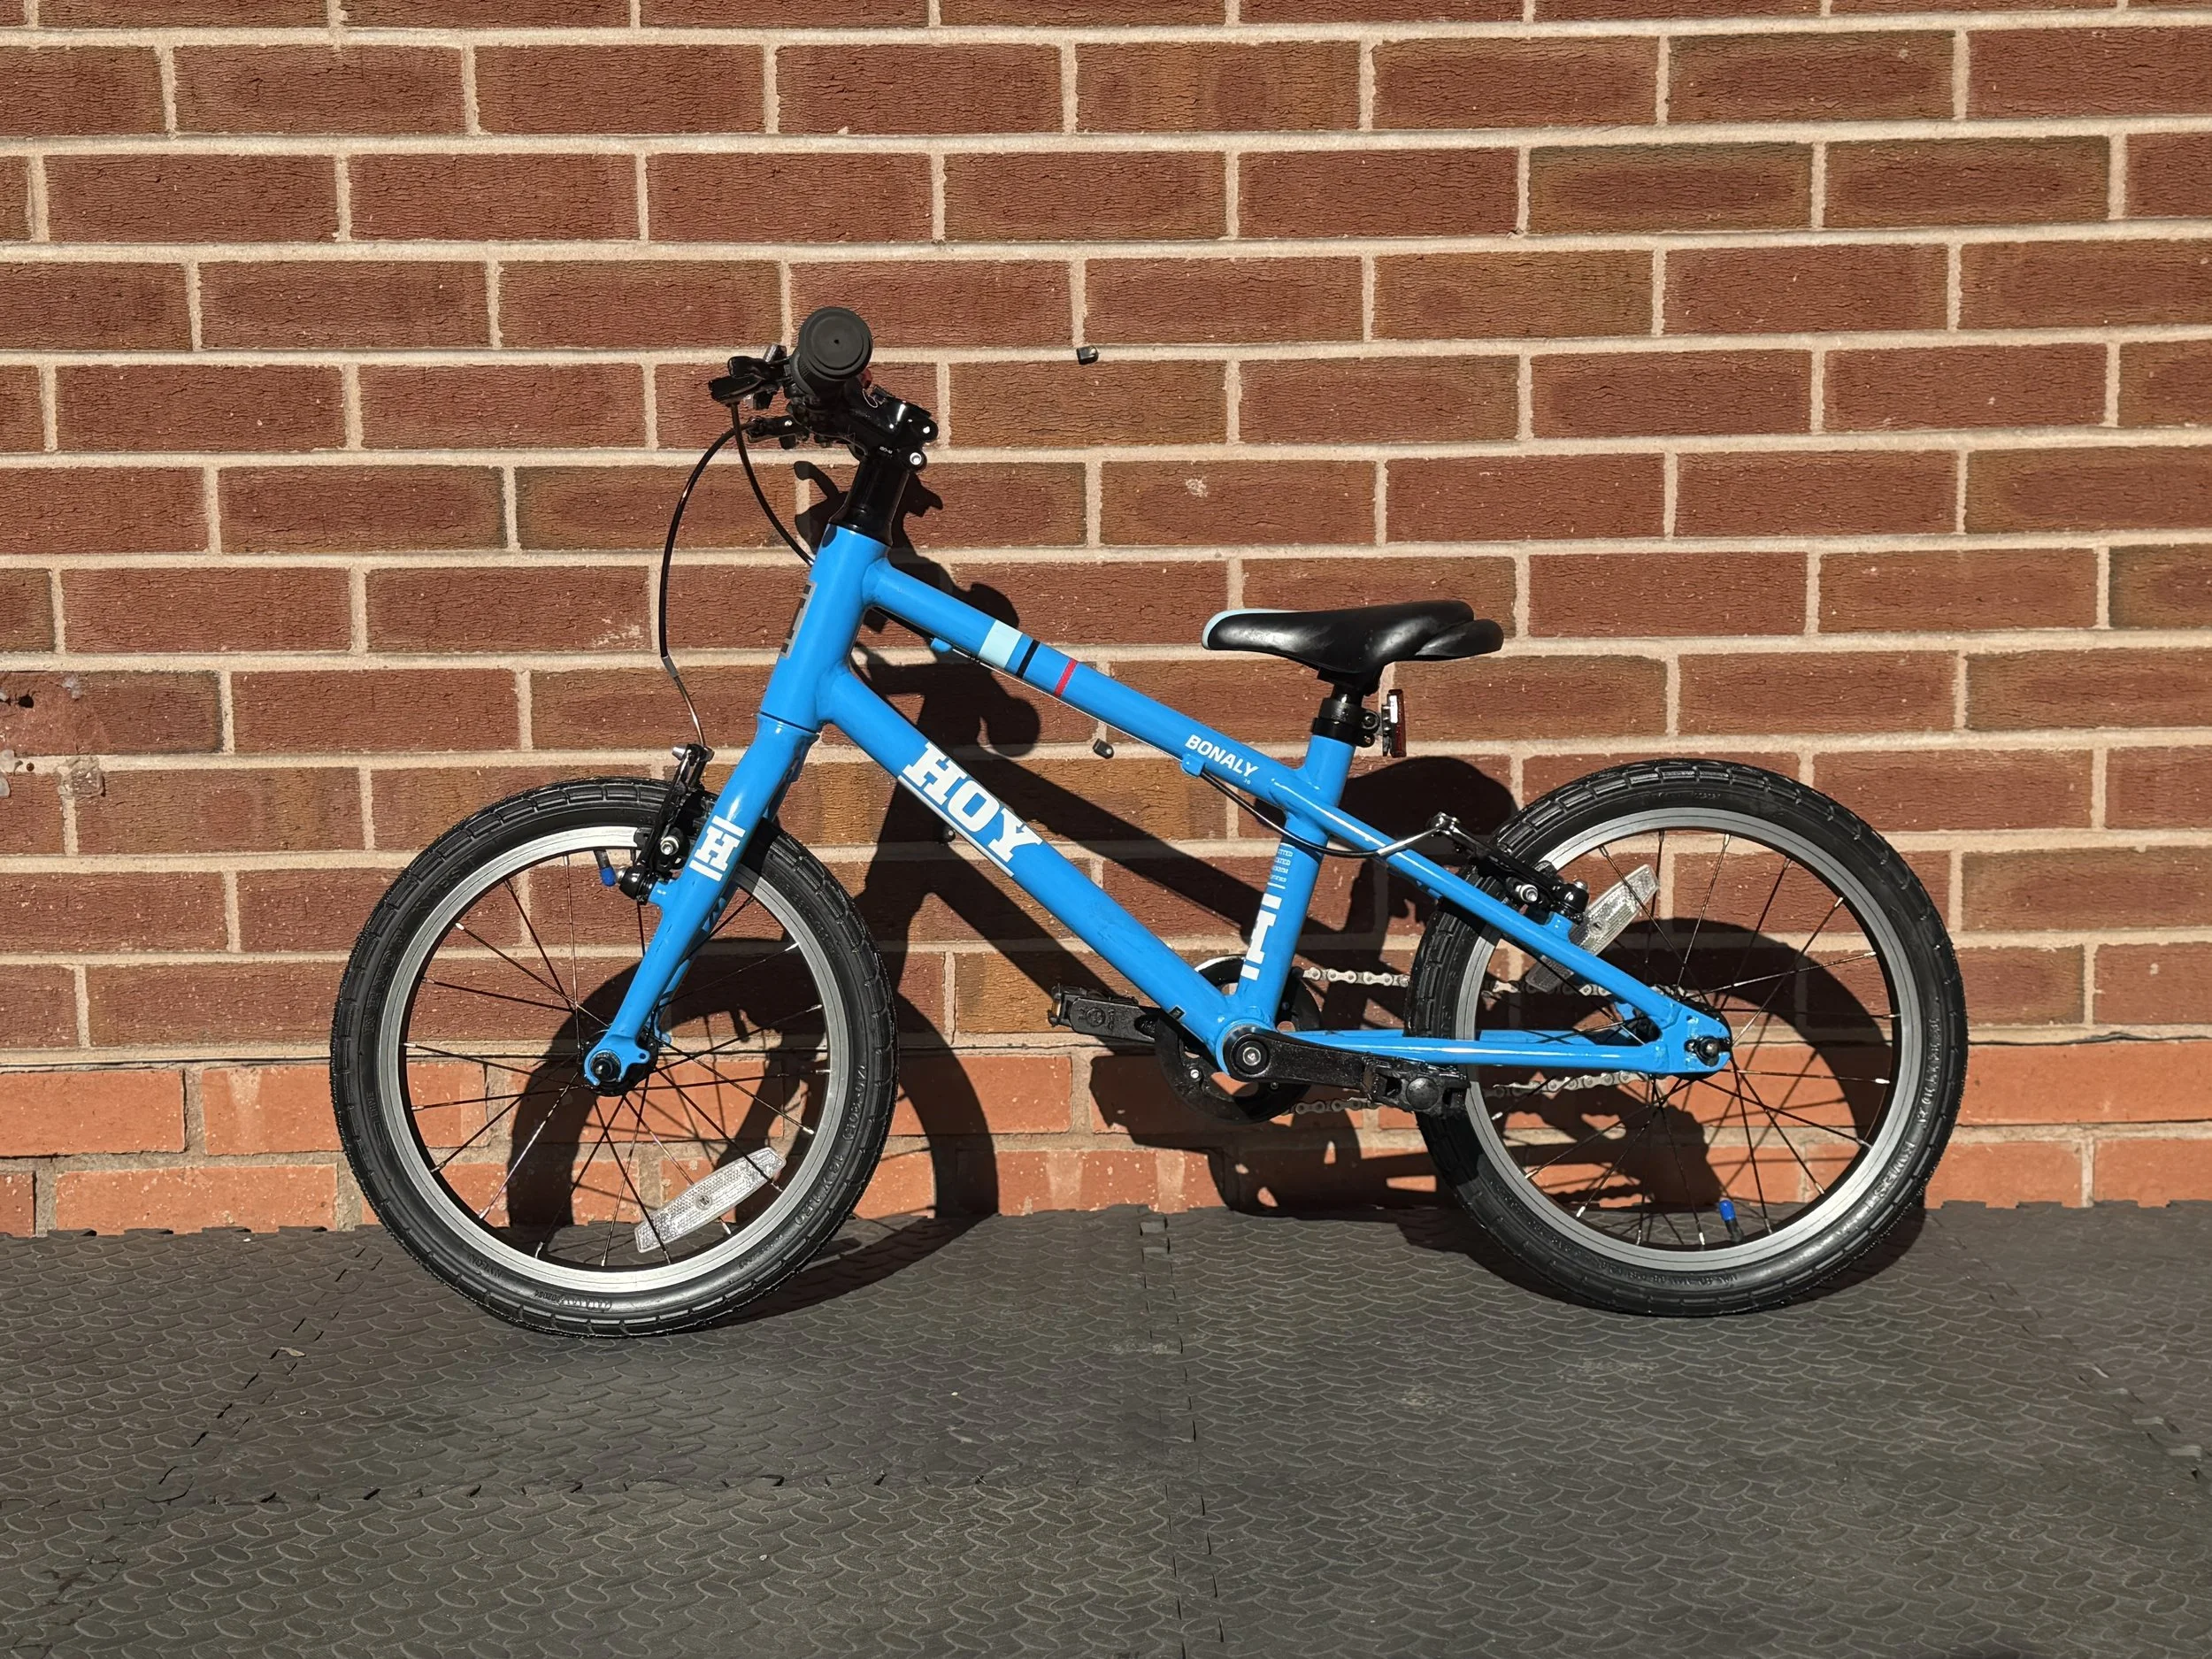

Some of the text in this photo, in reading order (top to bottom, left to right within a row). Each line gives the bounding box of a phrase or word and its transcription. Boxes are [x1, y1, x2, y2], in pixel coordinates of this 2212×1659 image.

[1185, 734, 1259, 777] BONALY
[902, 741, 1042, 862] HOY
[694, 825, 741, 872] H
